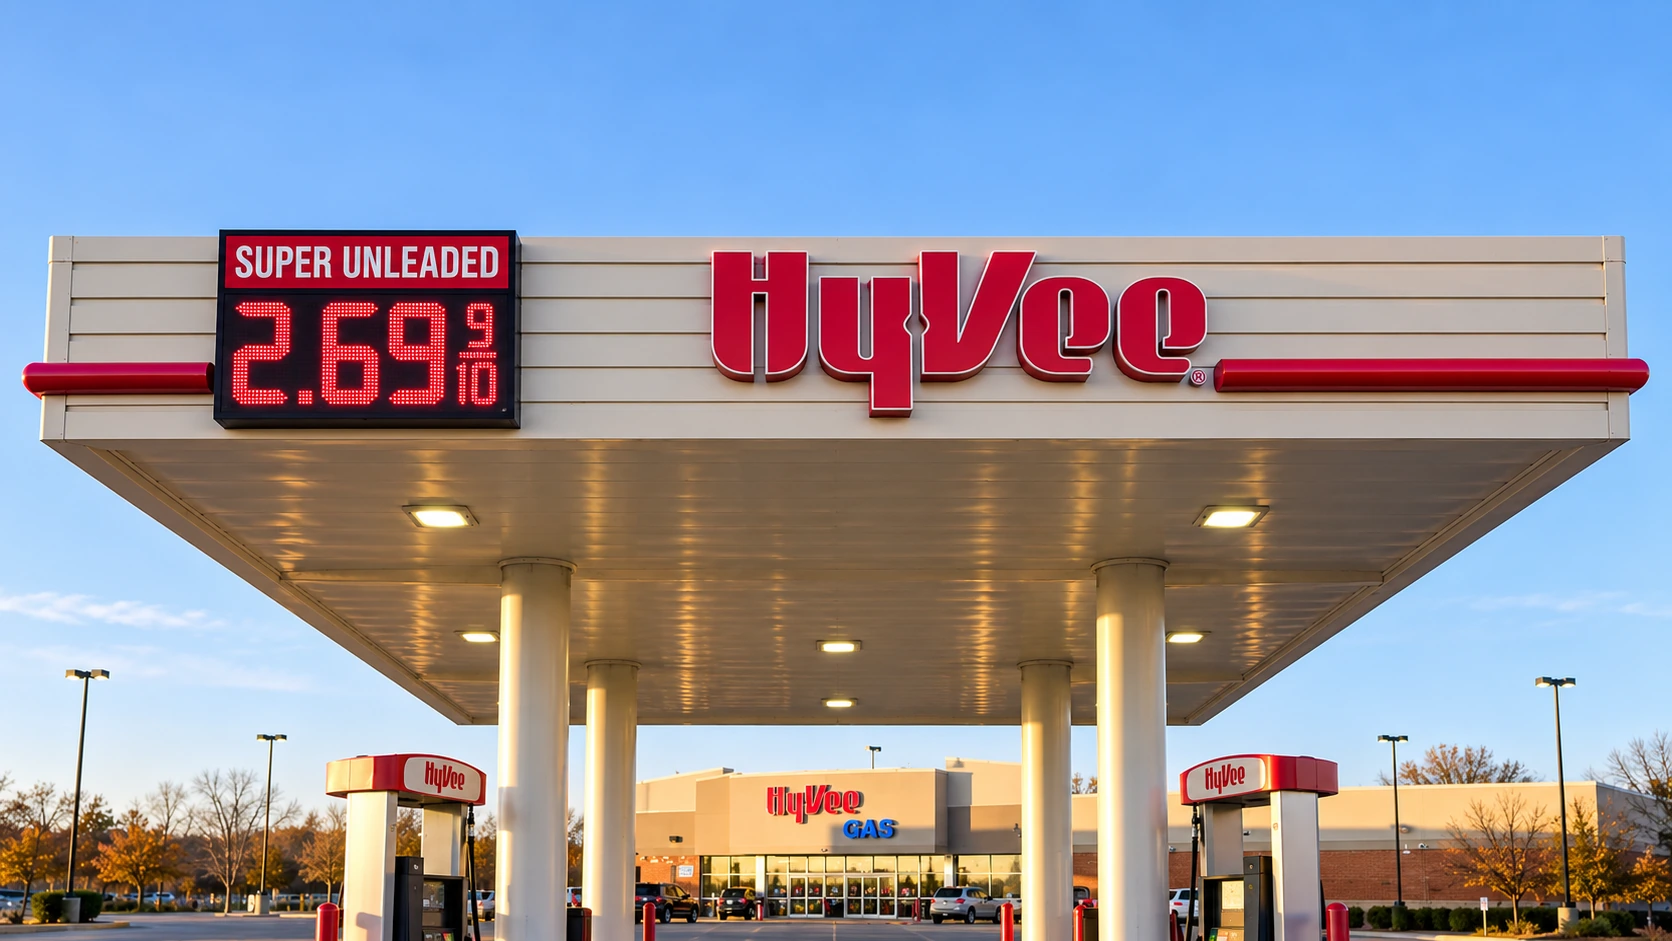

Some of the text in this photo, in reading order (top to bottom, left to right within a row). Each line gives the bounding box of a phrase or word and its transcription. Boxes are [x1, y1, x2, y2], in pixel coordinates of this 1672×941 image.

[235, 245, 499, 278] SUPER UNLEADED
[466, 303, 494, 348] 9
[711, 250, 1208, 418] HyVee
[232, 302, 446, 405] 2.69
[456, 361, 497, 405] 10
[424, 761, 465, 793] HyVee
[1205, 763, 1245, 794] HyVee
[766, 784, 863, 824] HyVee
[842, 819, 898, 839] GAS
